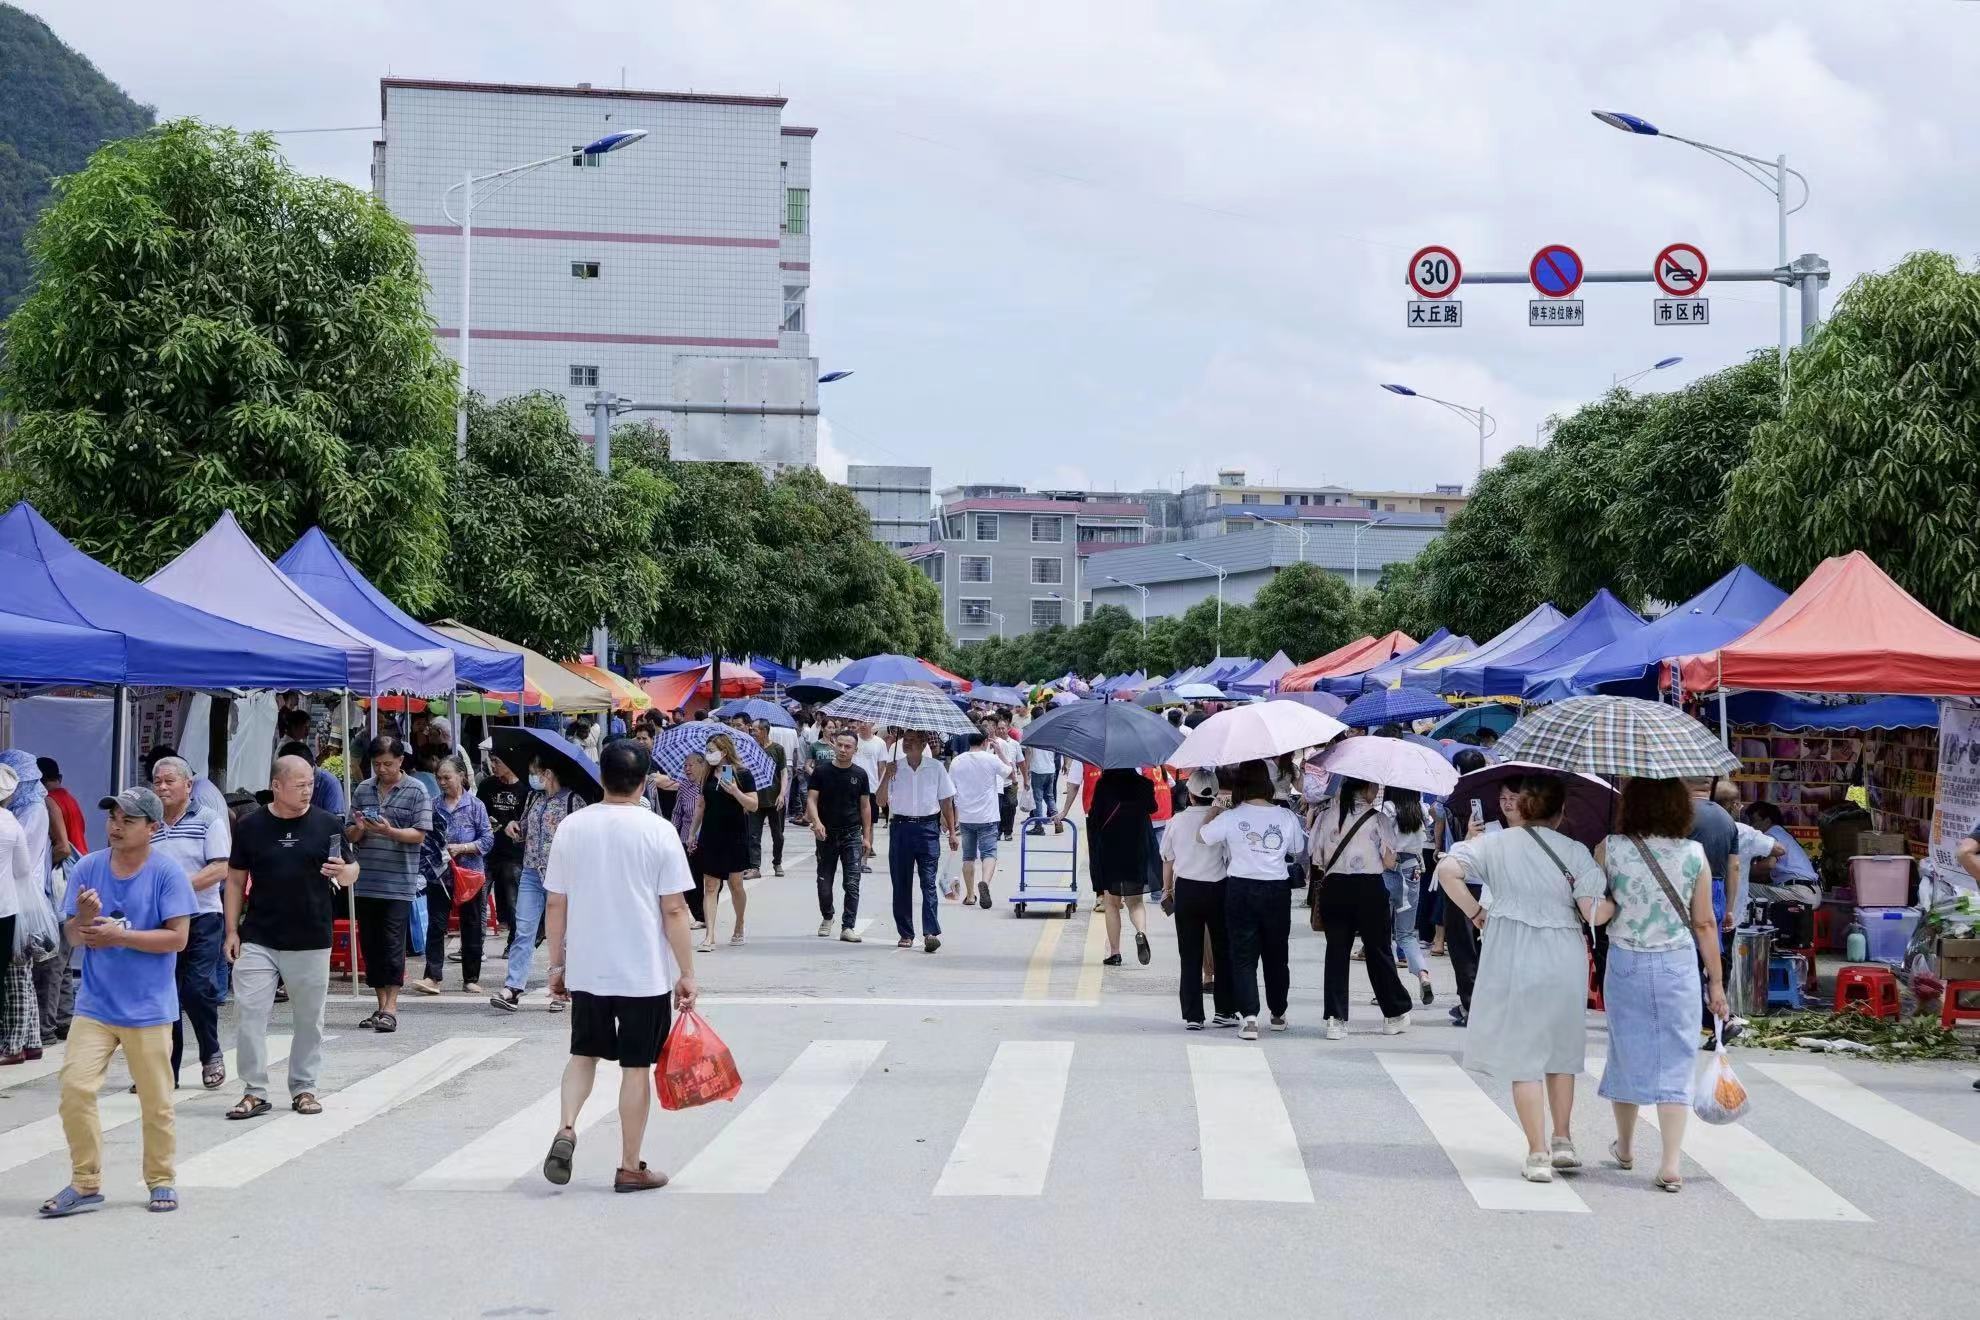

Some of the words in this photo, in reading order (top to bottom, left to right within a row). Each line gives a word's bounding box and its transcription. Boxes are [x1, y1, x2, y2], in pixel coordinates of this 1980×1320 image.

[1421, 259, 1449, 285] 30
[1411, 304, 1458, 323] 大丘路
[1531, 305, 1582, 320] 停车泊位除外
[1659, 302, 1704, 321] 市区内
